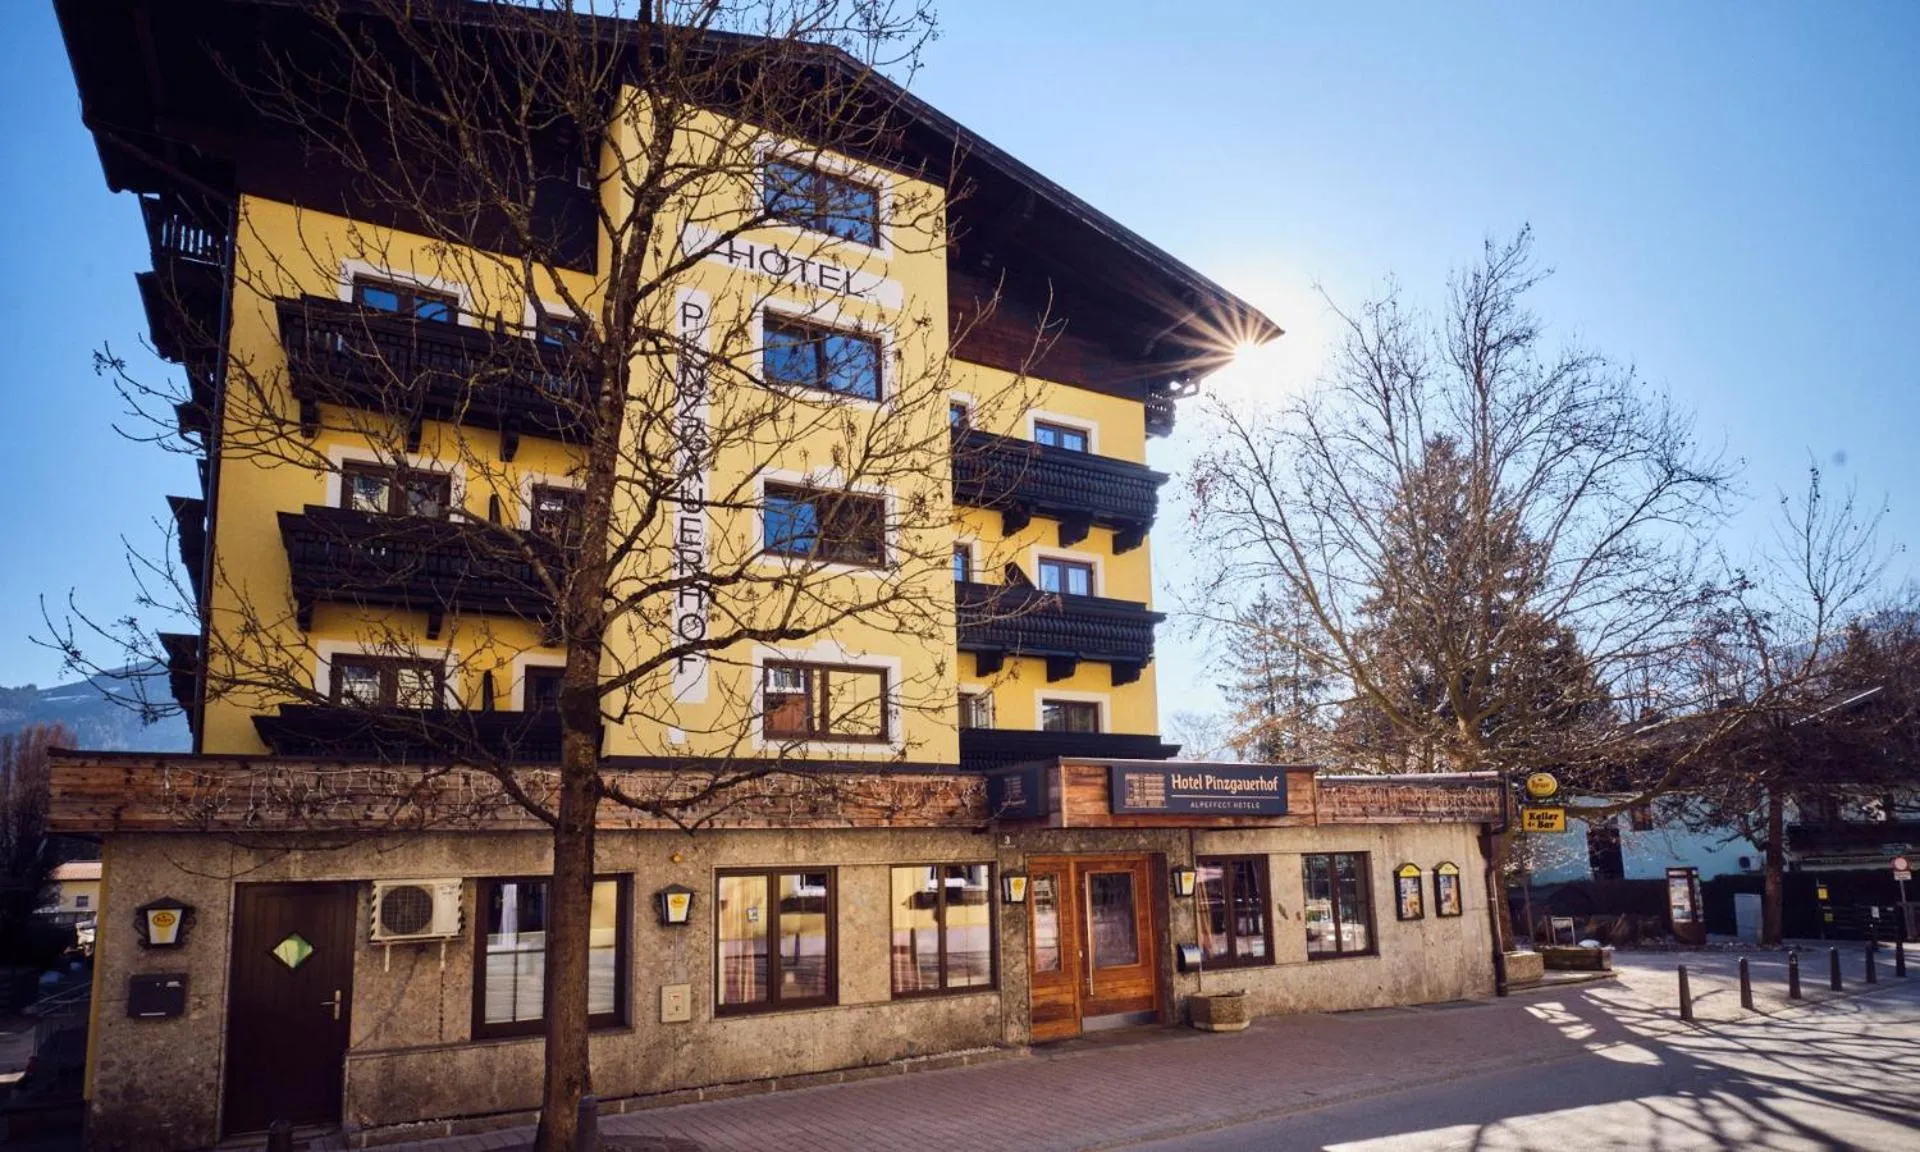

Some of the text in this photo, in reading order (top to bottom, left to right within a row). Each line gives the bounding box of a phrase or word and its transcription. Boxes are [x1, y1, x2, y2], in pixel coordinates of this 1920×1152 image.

[727, 240, 865, 299] HOTEL
[1171, 773, 1279, 794] Hotel Pinzgauerhof
[1190, 800, 1260, 809] ALPEFFECT HOTELS
[1528, 812, 1559, 820] Keller
[1537, 820, 1555, 828] Bar
